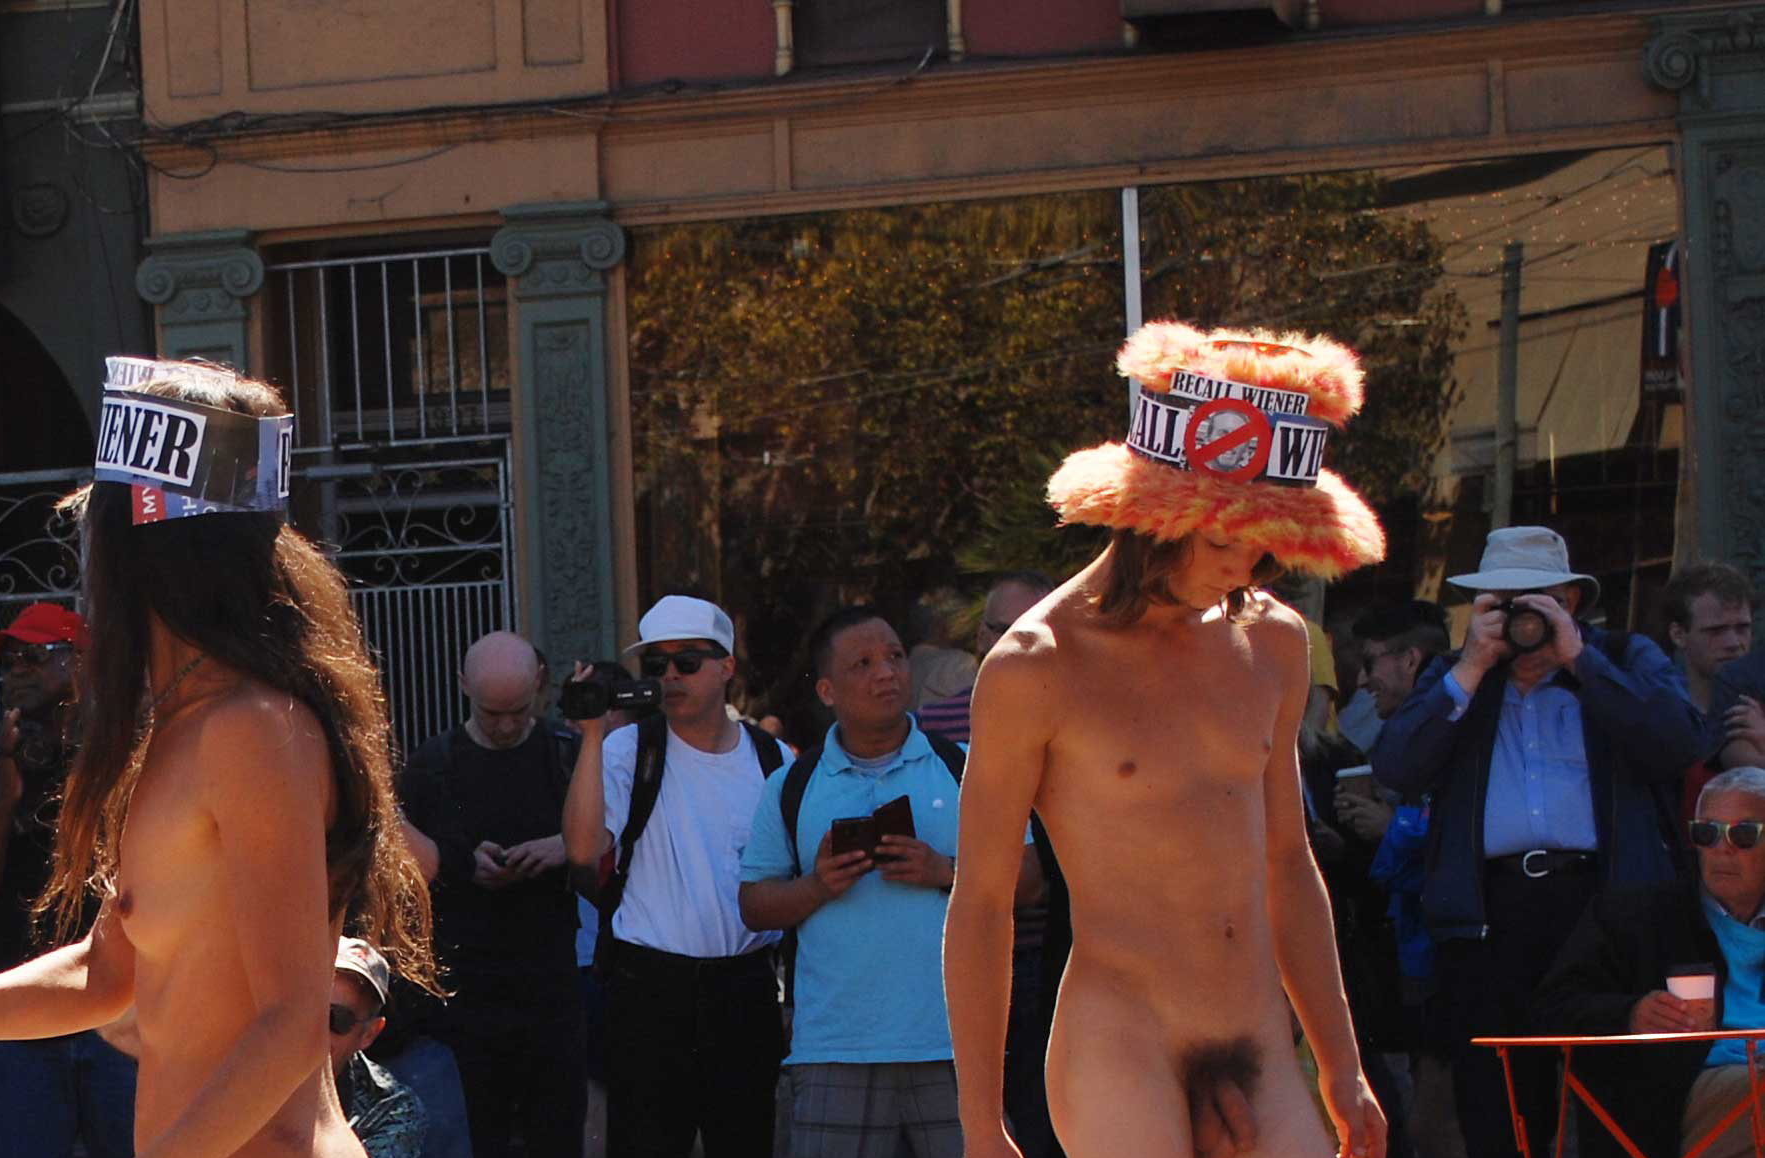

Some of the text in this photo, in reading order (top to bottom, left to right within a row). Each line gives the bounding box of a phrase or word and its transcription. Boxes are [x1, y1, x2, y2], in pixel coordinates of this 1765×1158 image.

[1173, 371, 1306, 414] RECALL WIENER
[98, 403, 198, 480] IENER
